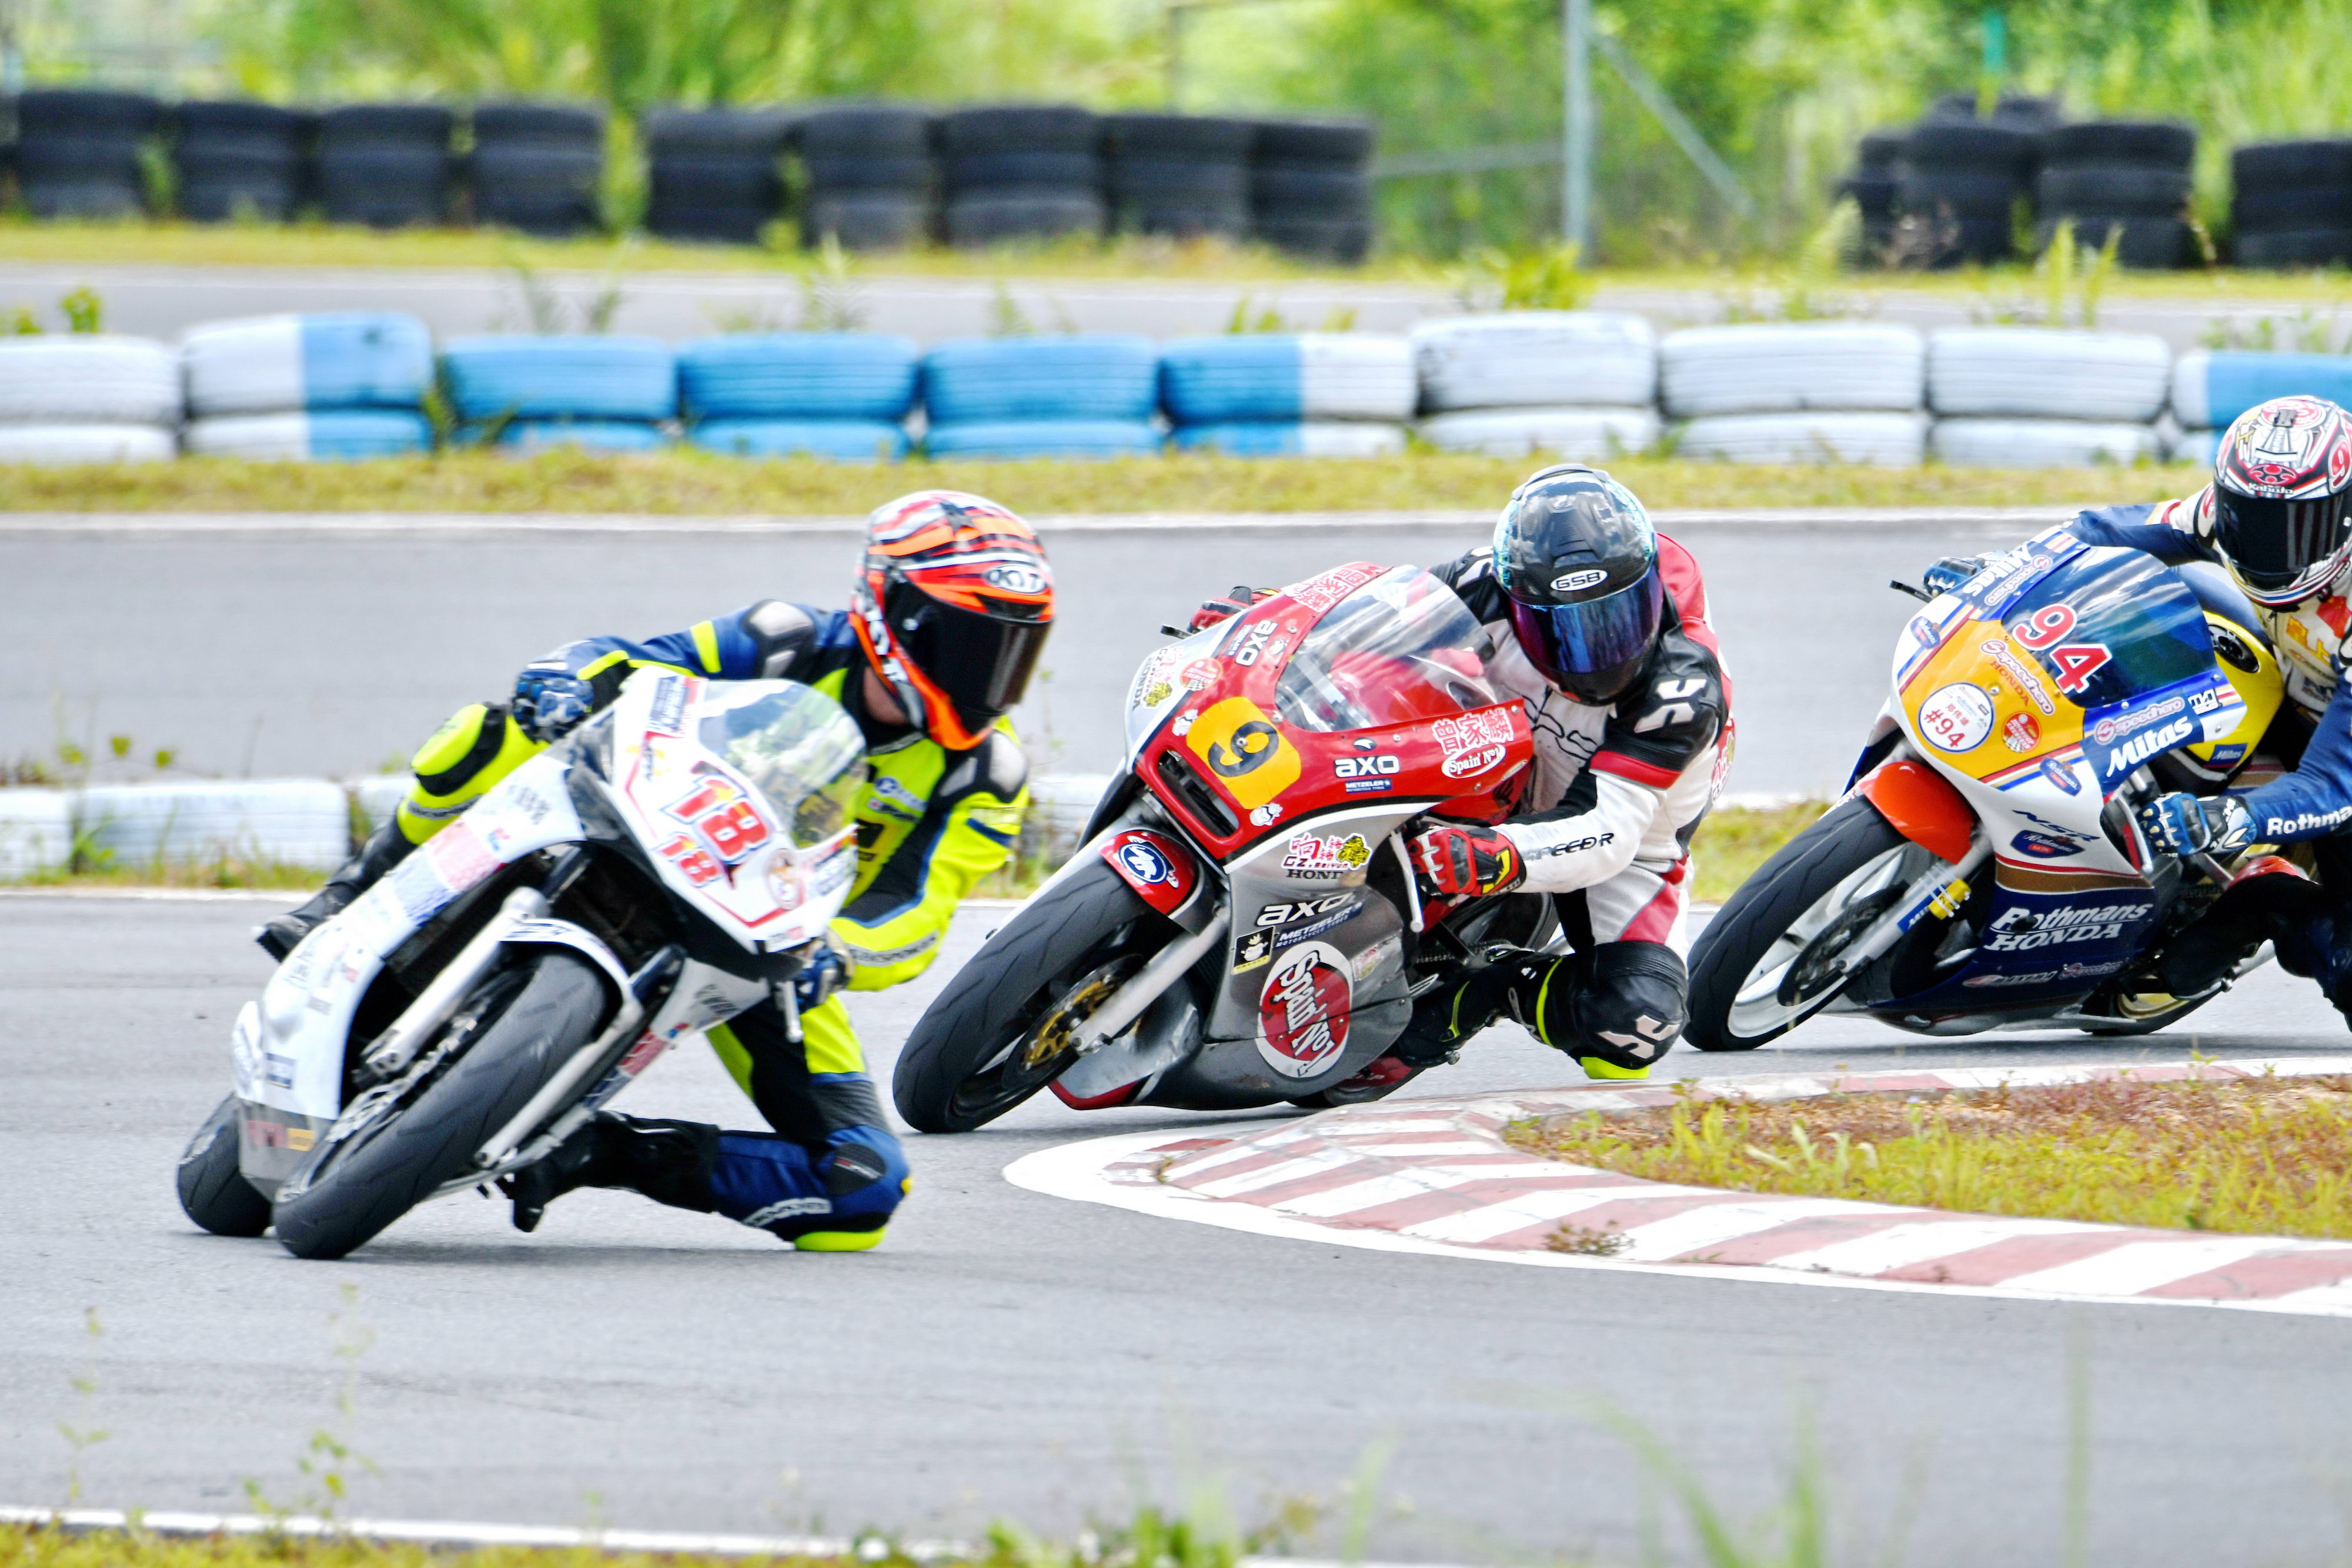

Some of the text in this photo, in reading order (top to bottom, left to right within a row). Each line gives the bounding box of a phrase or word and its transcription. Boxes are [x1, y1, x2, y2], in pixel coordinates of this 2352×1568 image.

[1556, 572, 1601, 589] GSB
[2013, 604, 2112, 694] 94
[1990, 661, 2029, 707] HONDA
[1208, 721, 1279, 777] 9
[1924, 709, 1965, 747] #94
[2106, 716, 2193, 777] Mitas
[1334, 755, 1399, 778] axo
[661, 774, 776, 864] 18
[2267, 805, 2352, 836] Rothma
[655, 834, 722, 887] 18
[1983, 923, 2123, 951] HONDA
